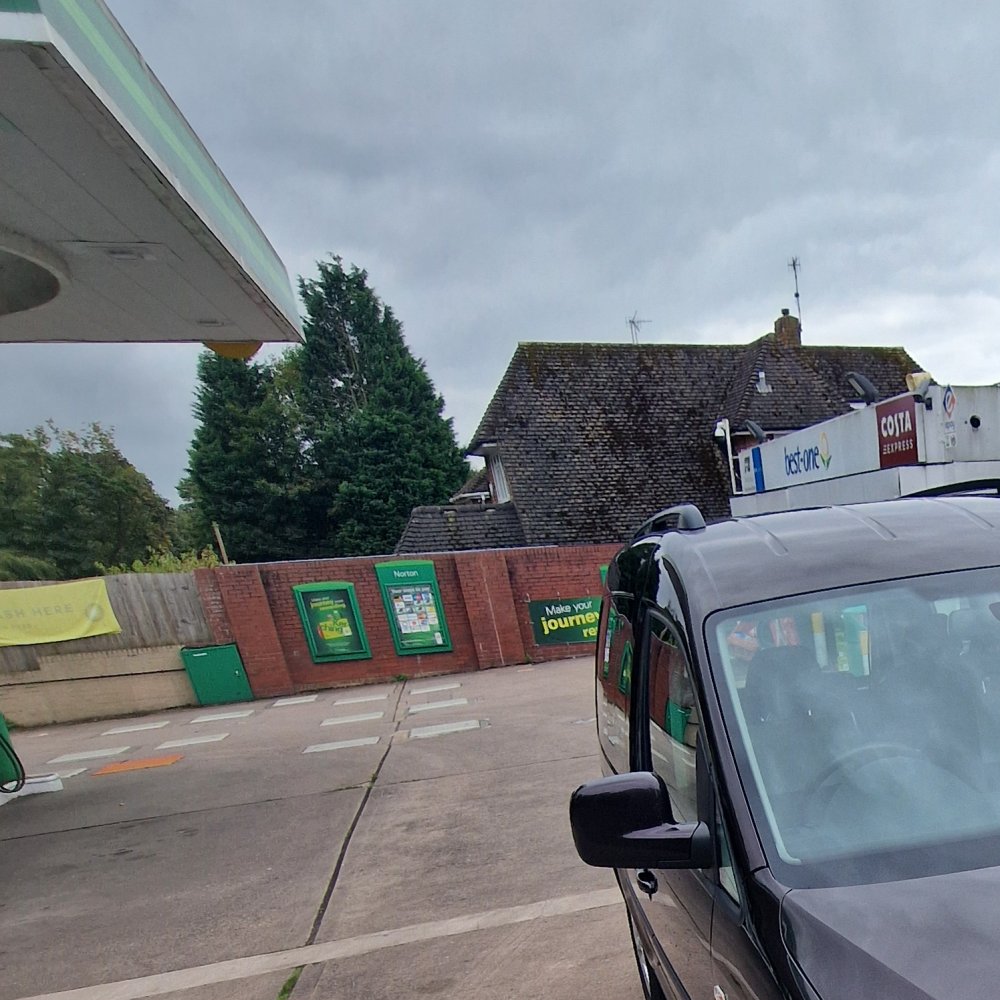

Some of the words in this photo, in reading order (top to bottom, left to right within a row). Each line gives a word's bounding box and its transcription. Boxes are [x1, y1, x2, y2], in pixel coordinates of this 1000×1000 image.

[880, 410, 912, 438] COSTA
[883, 439, 914, 455] EXPRESS
[393, 570, 419, 578] Norton
[545, 604, 571, 616] Make
[573, 600, 593, 612] your
